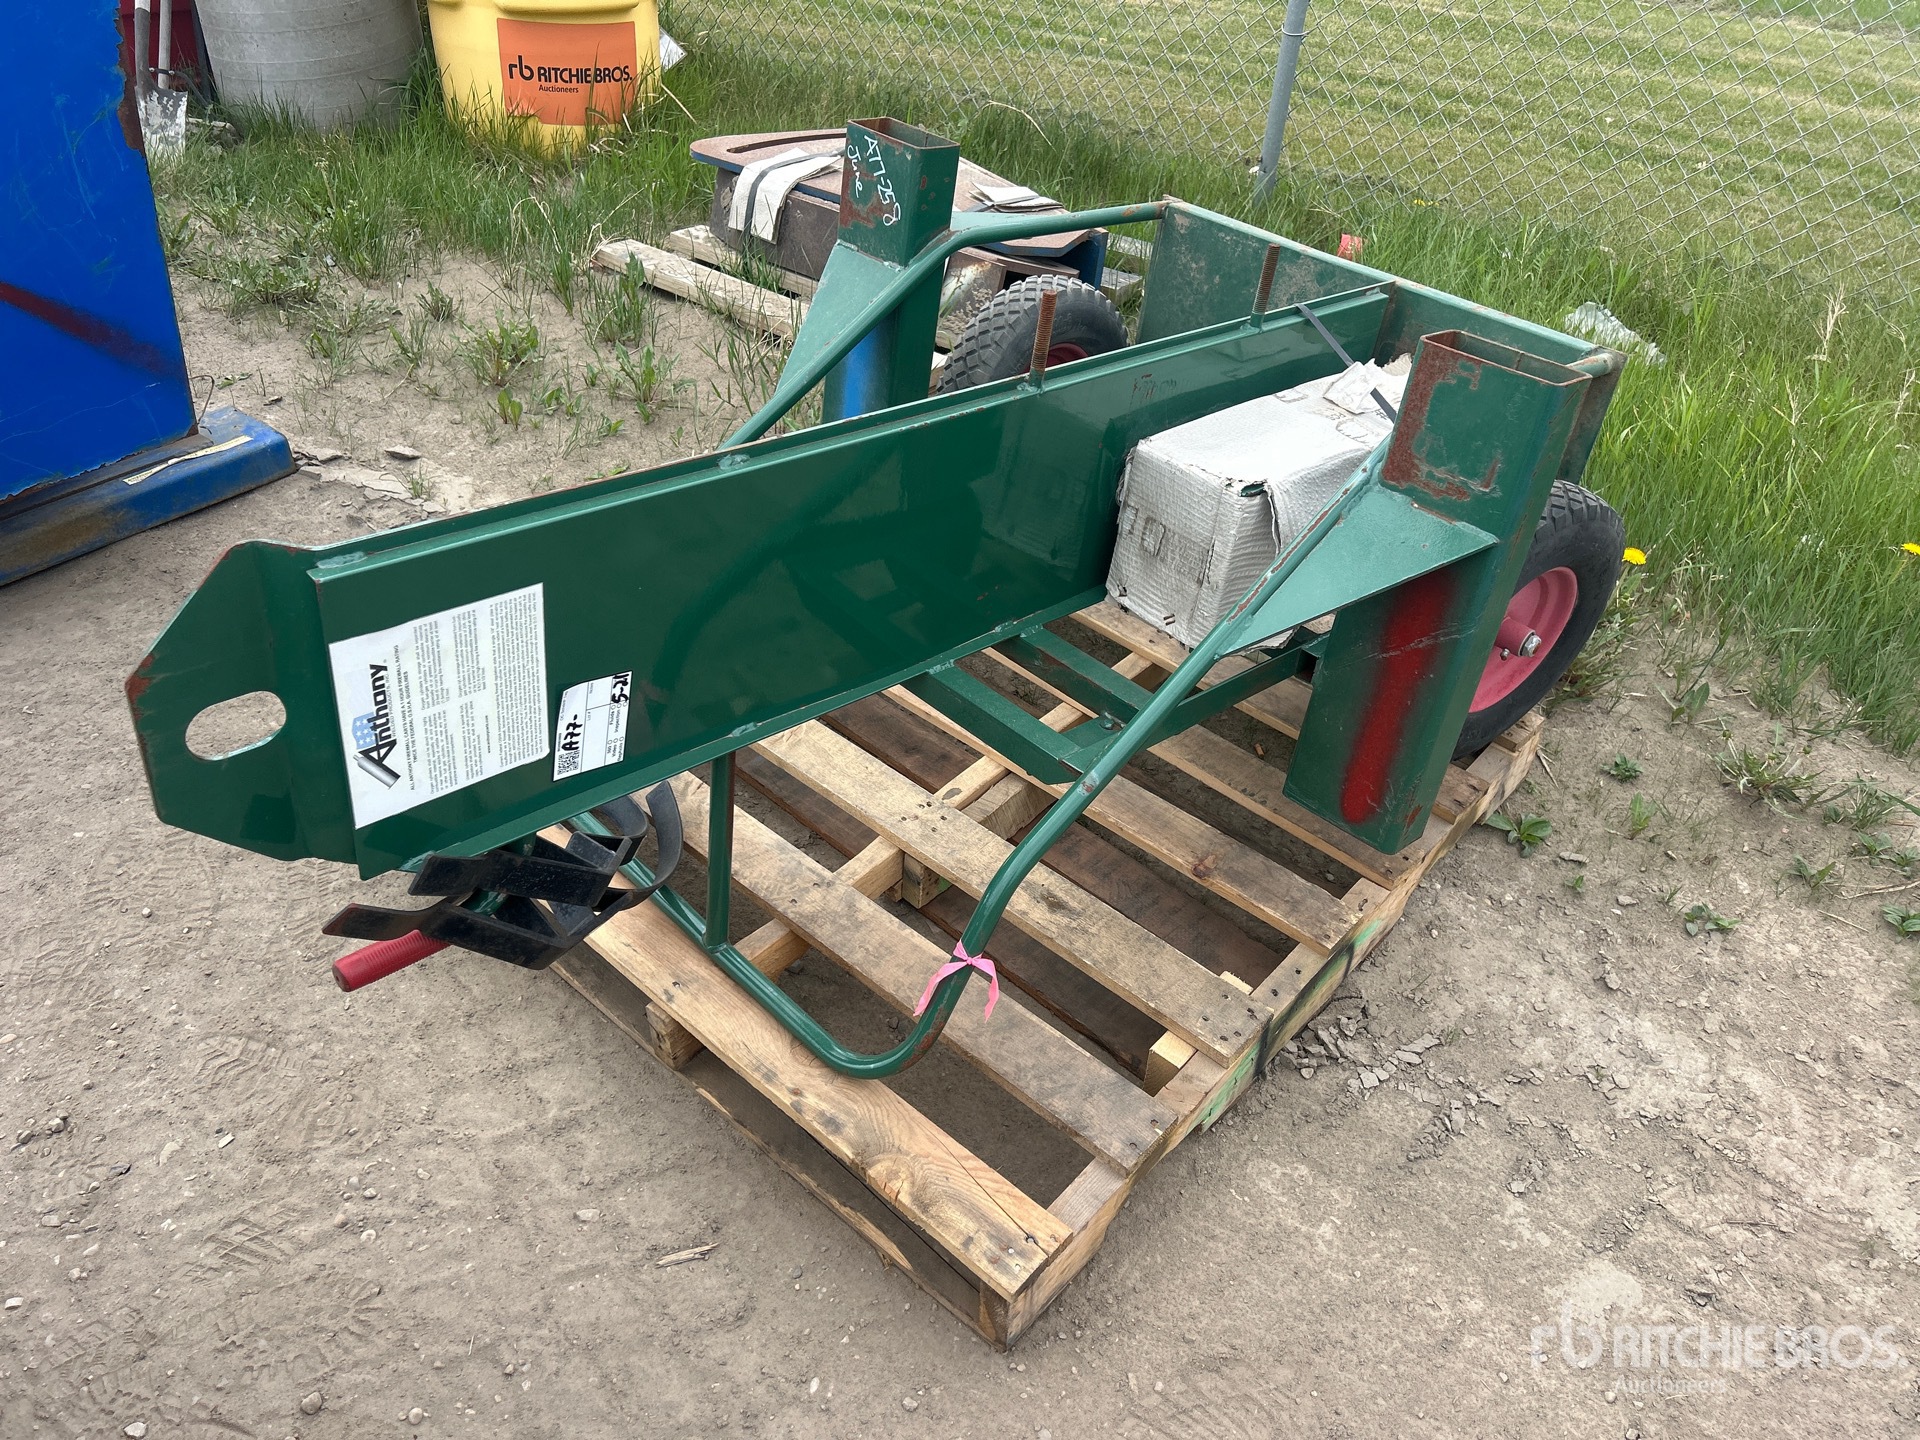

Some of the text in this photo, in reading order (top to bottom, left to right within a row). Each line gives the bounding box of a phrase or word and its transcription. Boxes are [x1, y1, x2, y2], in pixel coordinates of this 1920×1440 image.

[537, 66, 592, 84] RITCHIE
[594, 65, 633, 84] BROS.
[538, 84, 579, 93] Auctioneers
[355, 663, 400, 785] Anthony
